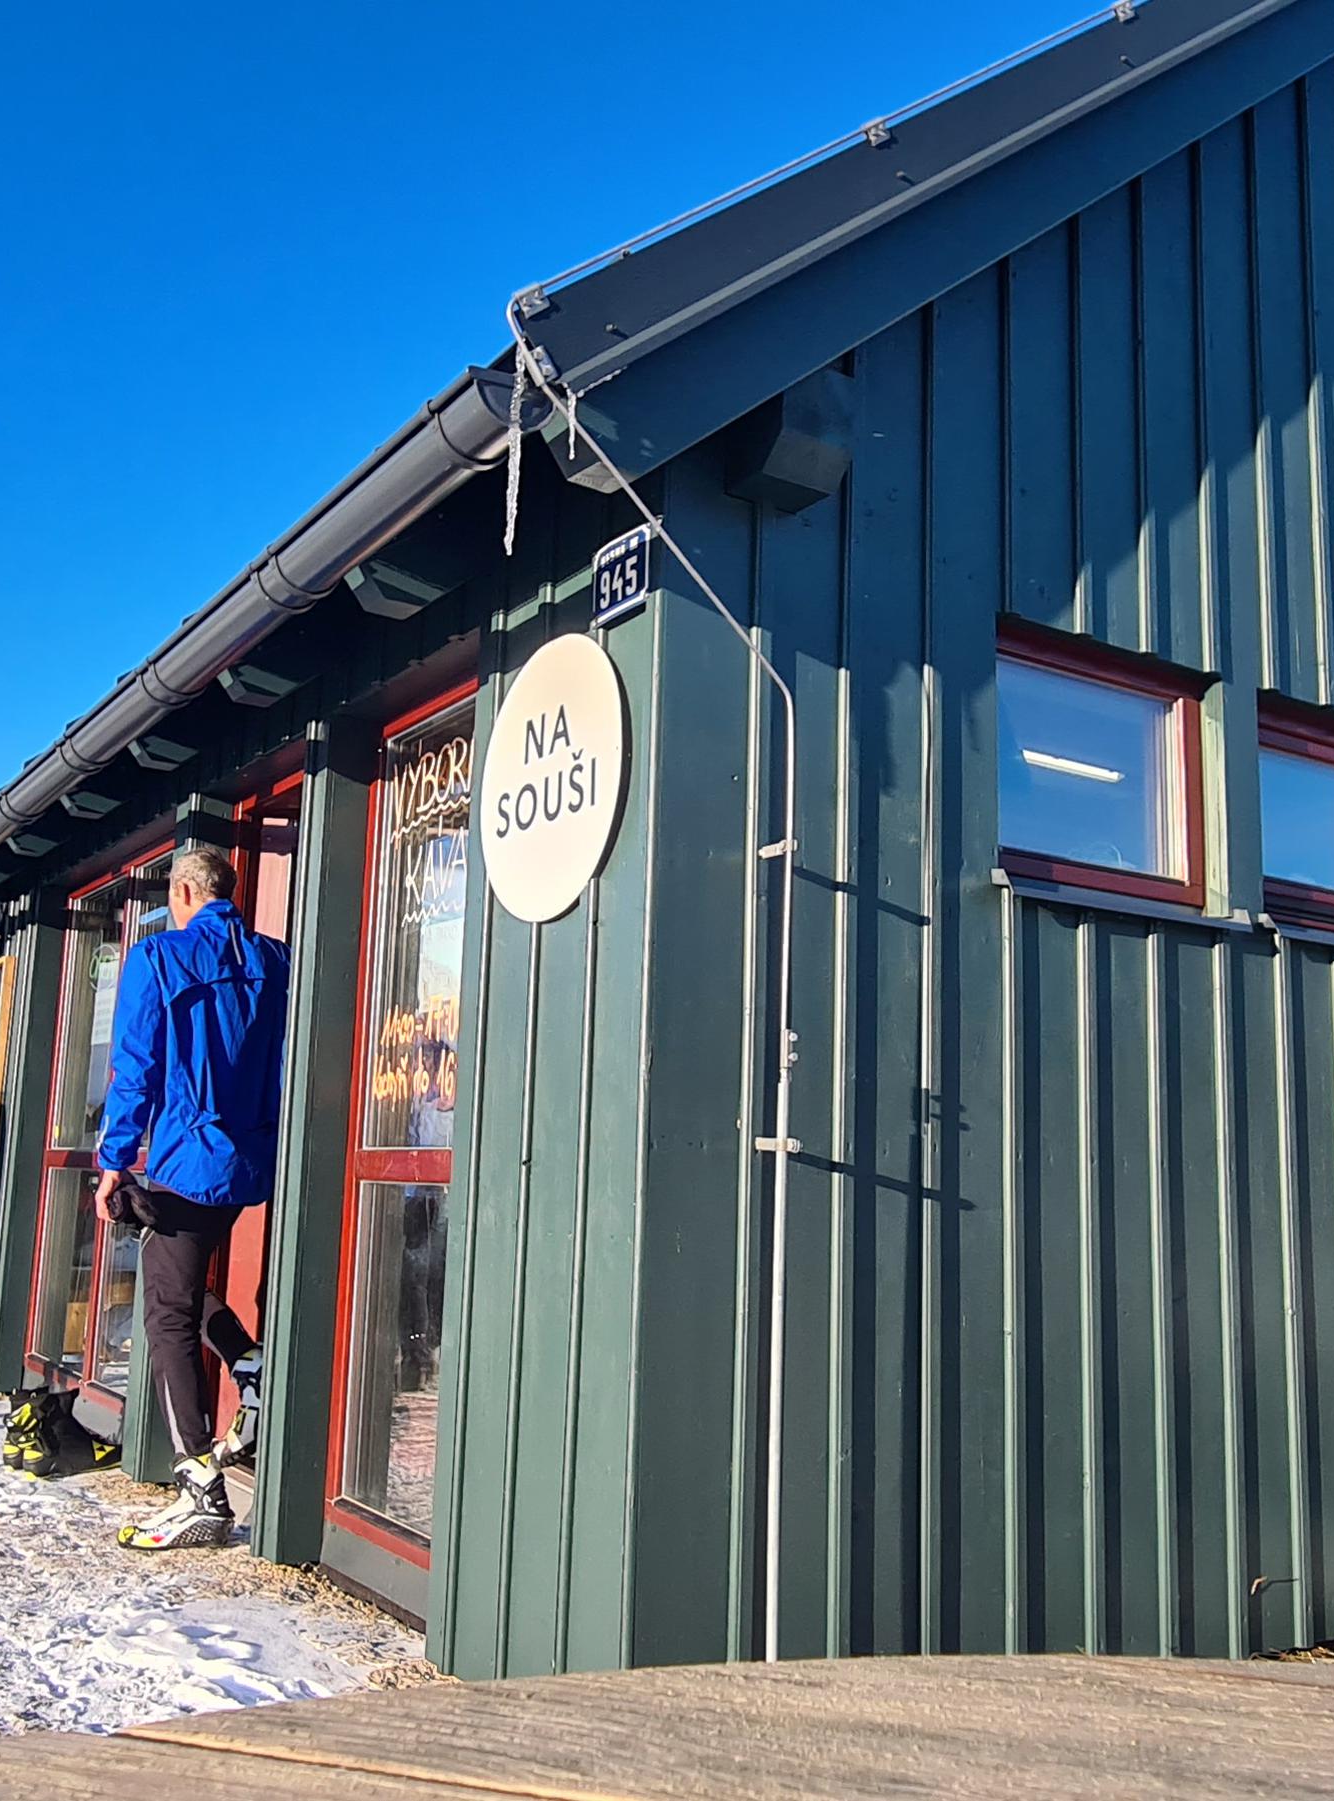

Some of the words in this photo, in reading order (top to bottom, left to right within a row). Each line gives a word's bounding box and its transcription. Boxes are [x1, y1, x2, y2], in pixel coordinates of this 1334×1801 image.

[599, 555, 638, 609] 945
[524, 704, 570, 765] NA
[393, 737, 475, 824] VÝBOR
[496, 748, 596, 838] SOUŠI
[406, 814, 467, 904] KÁVA
[413, 1046, 430, 1097] do
